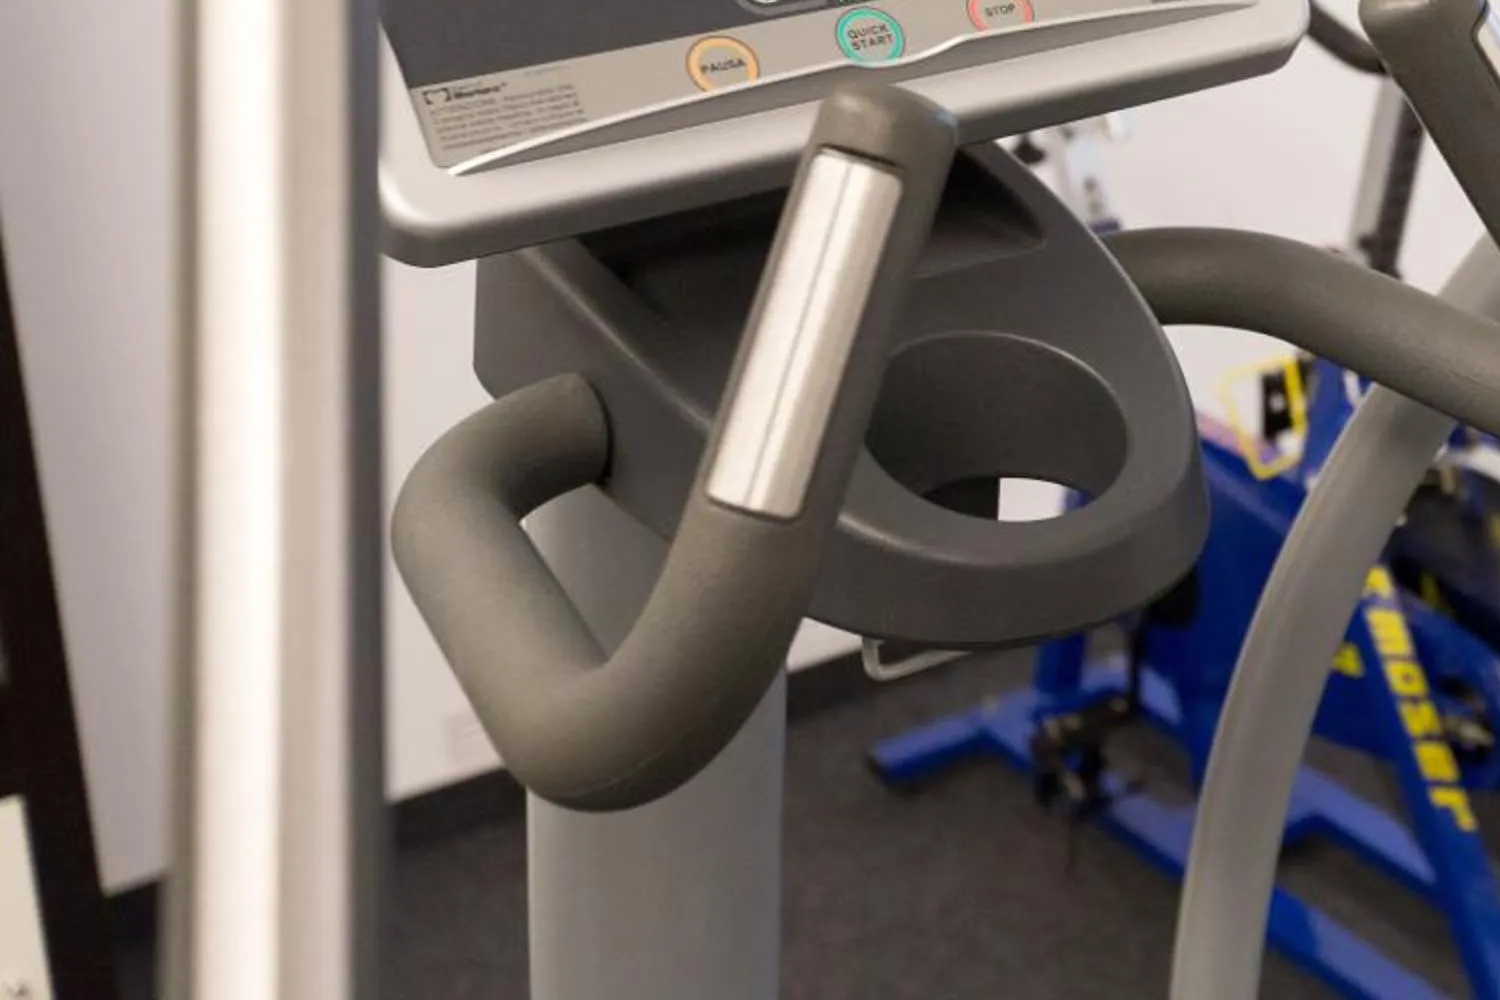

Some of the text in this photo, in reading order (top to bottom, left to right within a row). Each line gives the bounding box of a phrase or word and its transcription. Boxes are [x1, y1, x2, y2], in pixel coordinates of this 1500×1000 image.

[984, 3, 1017, 19] STOP
[847, 23, 890, 40] QUICK
[850, 34, 893, 51] START
[699, 56, 747, 76] PAUSA
